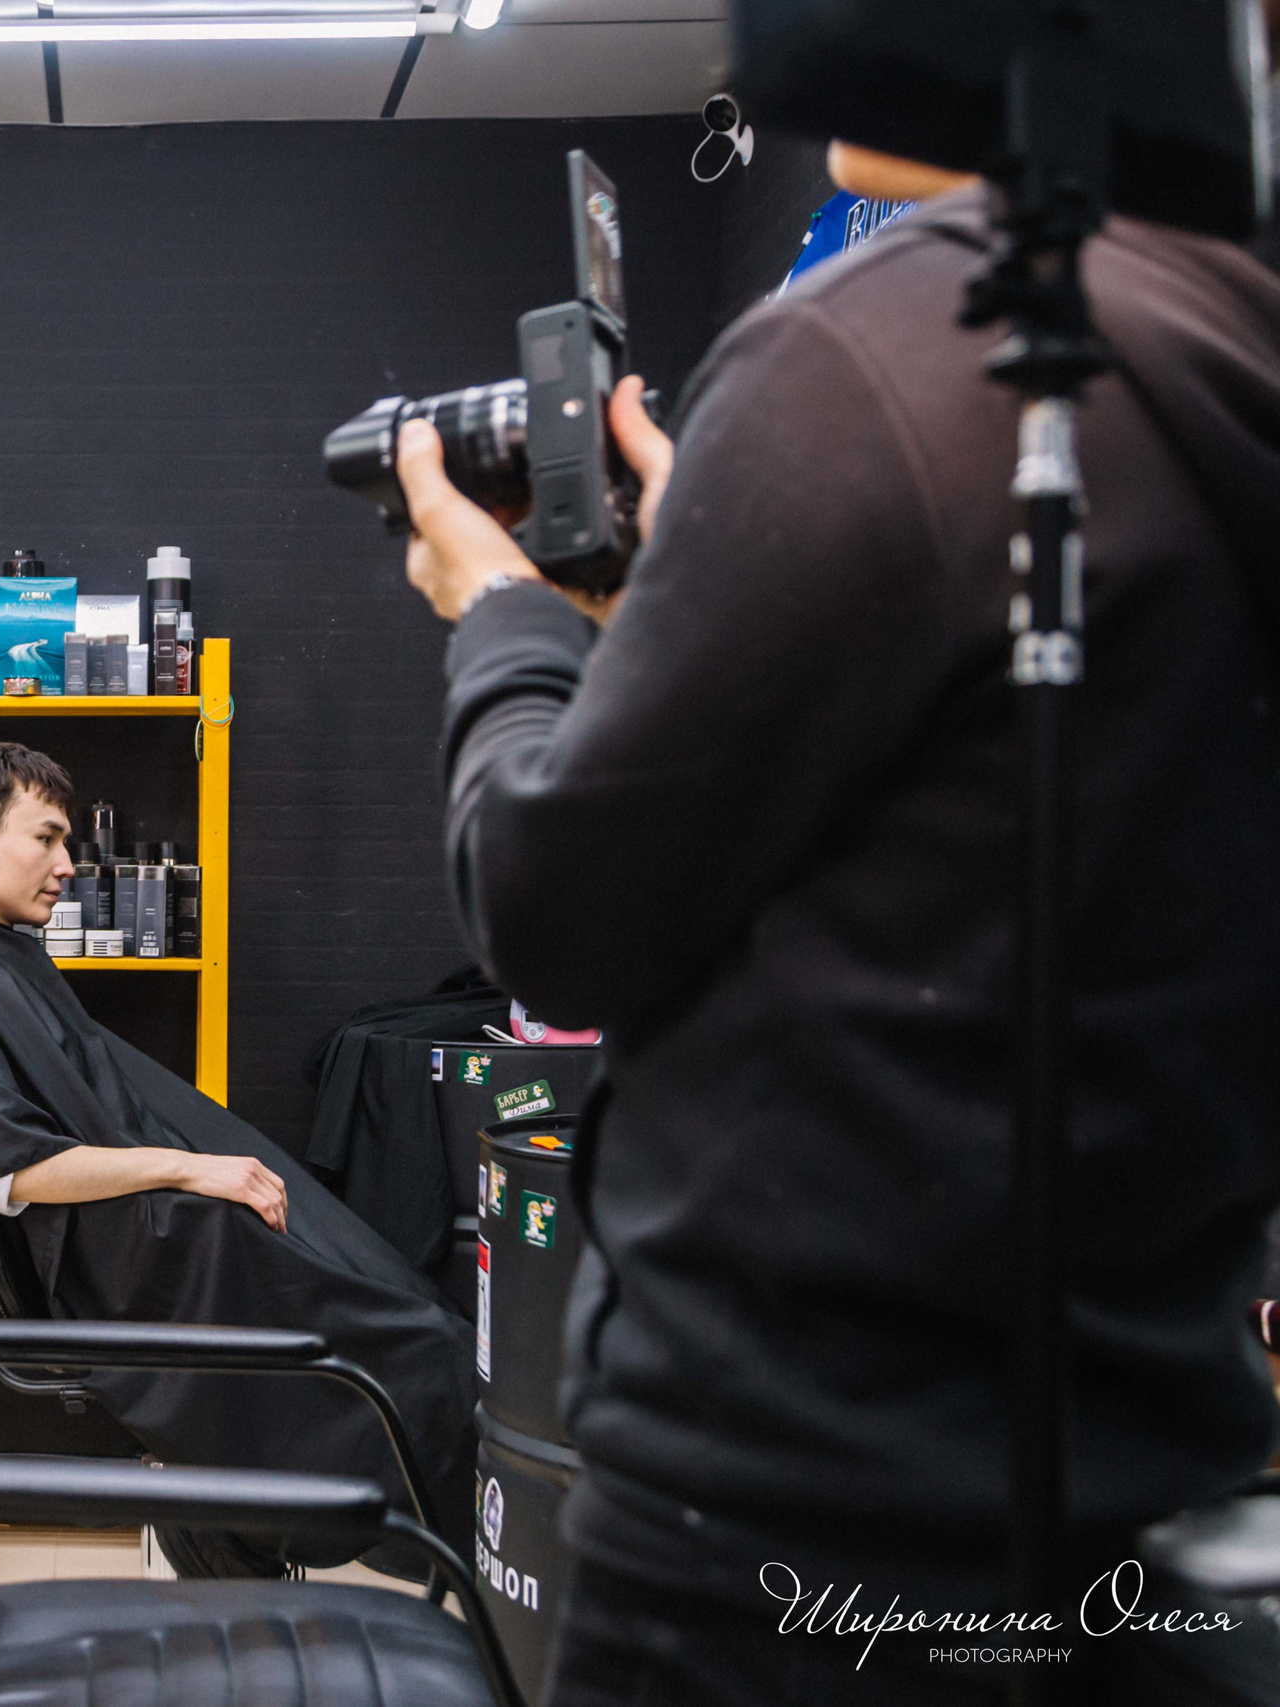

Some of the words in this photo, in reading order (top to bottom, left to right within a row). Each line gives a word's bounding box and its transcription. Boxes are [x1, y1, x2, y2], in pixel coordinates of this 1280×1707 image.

[19, 591, 52, 601] ALPHA
[5, 602, 64, 614] MARINE
[497, 1089, 528, 1108] БАРБЕР
[509, 1102, 541, 1116] Дима
